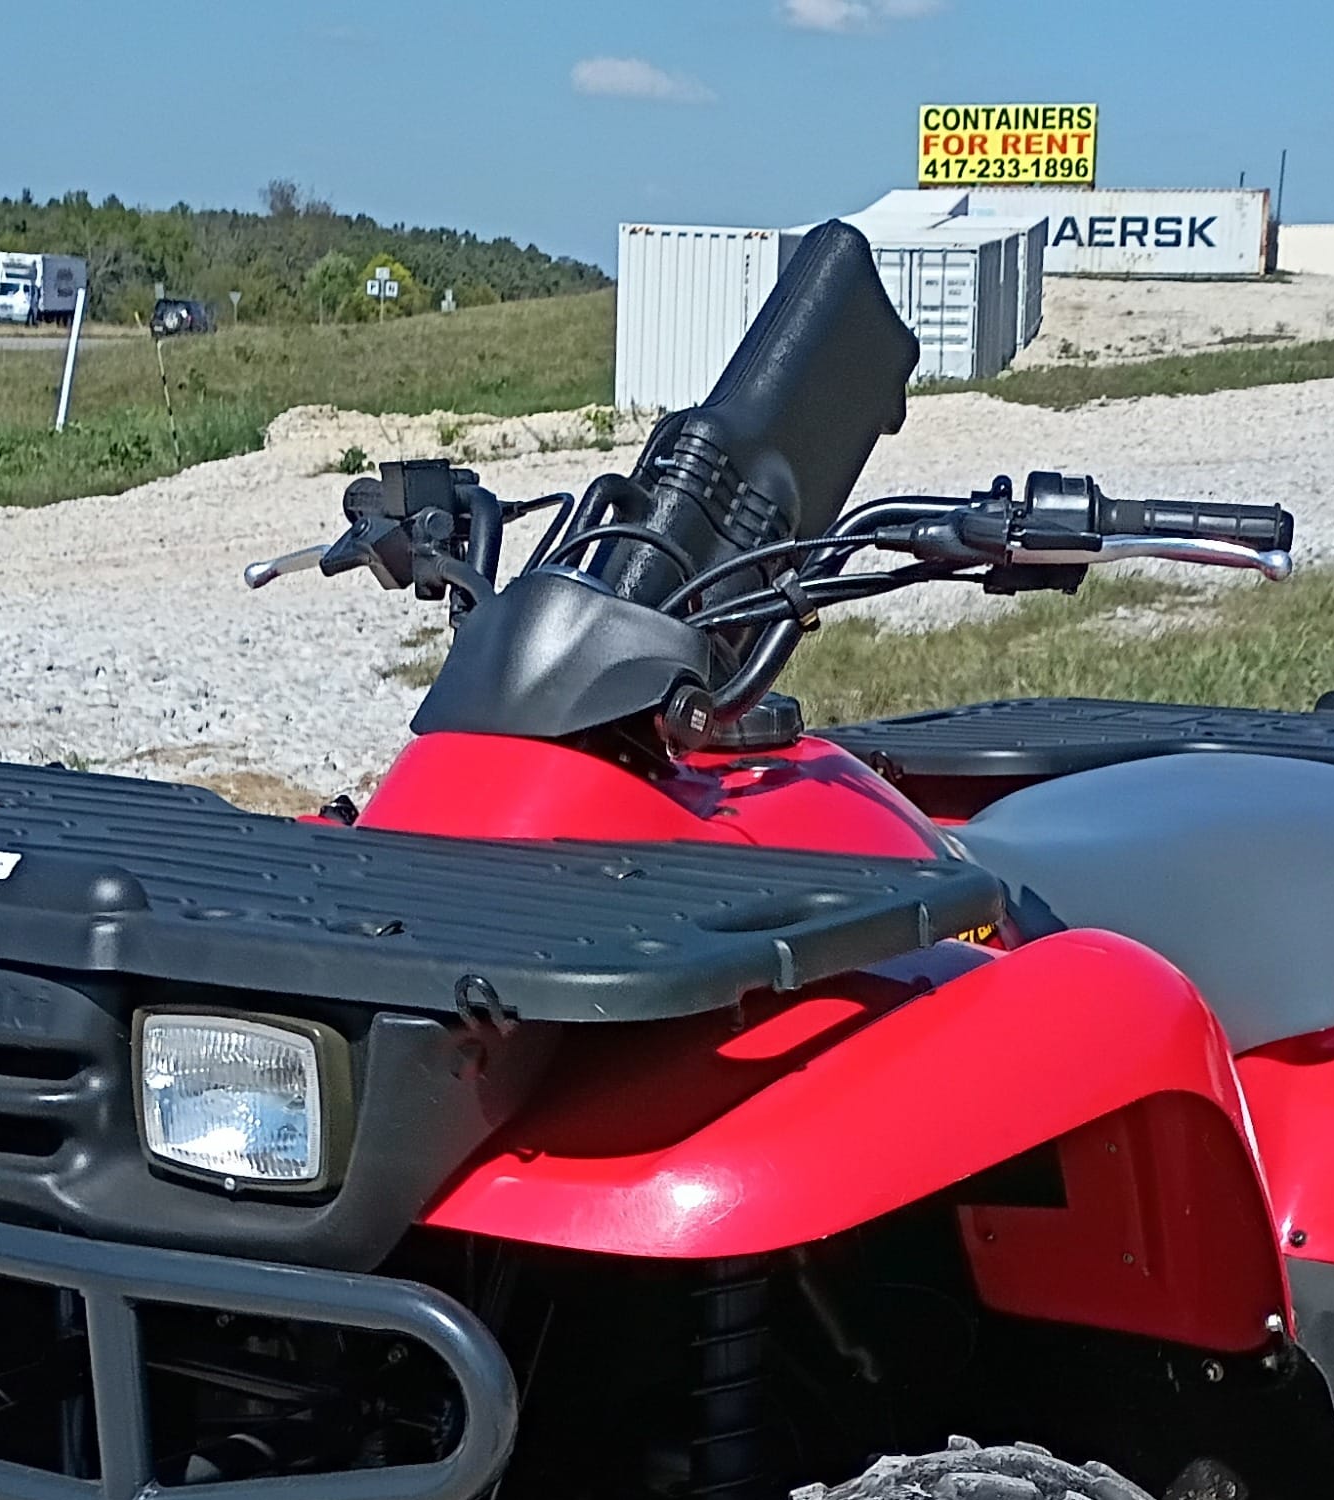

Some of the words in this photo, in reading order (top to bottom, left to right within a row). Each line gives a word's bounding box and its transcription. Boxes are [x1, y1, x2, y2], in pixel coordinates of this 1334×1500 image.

[923, 107, 1092, 131] CONTAINERS
[923, 134, 989, 156] FOR
[1001, 133, 1091, 156] RENT
[924, 157, 1089, 179] 417-233-1896
